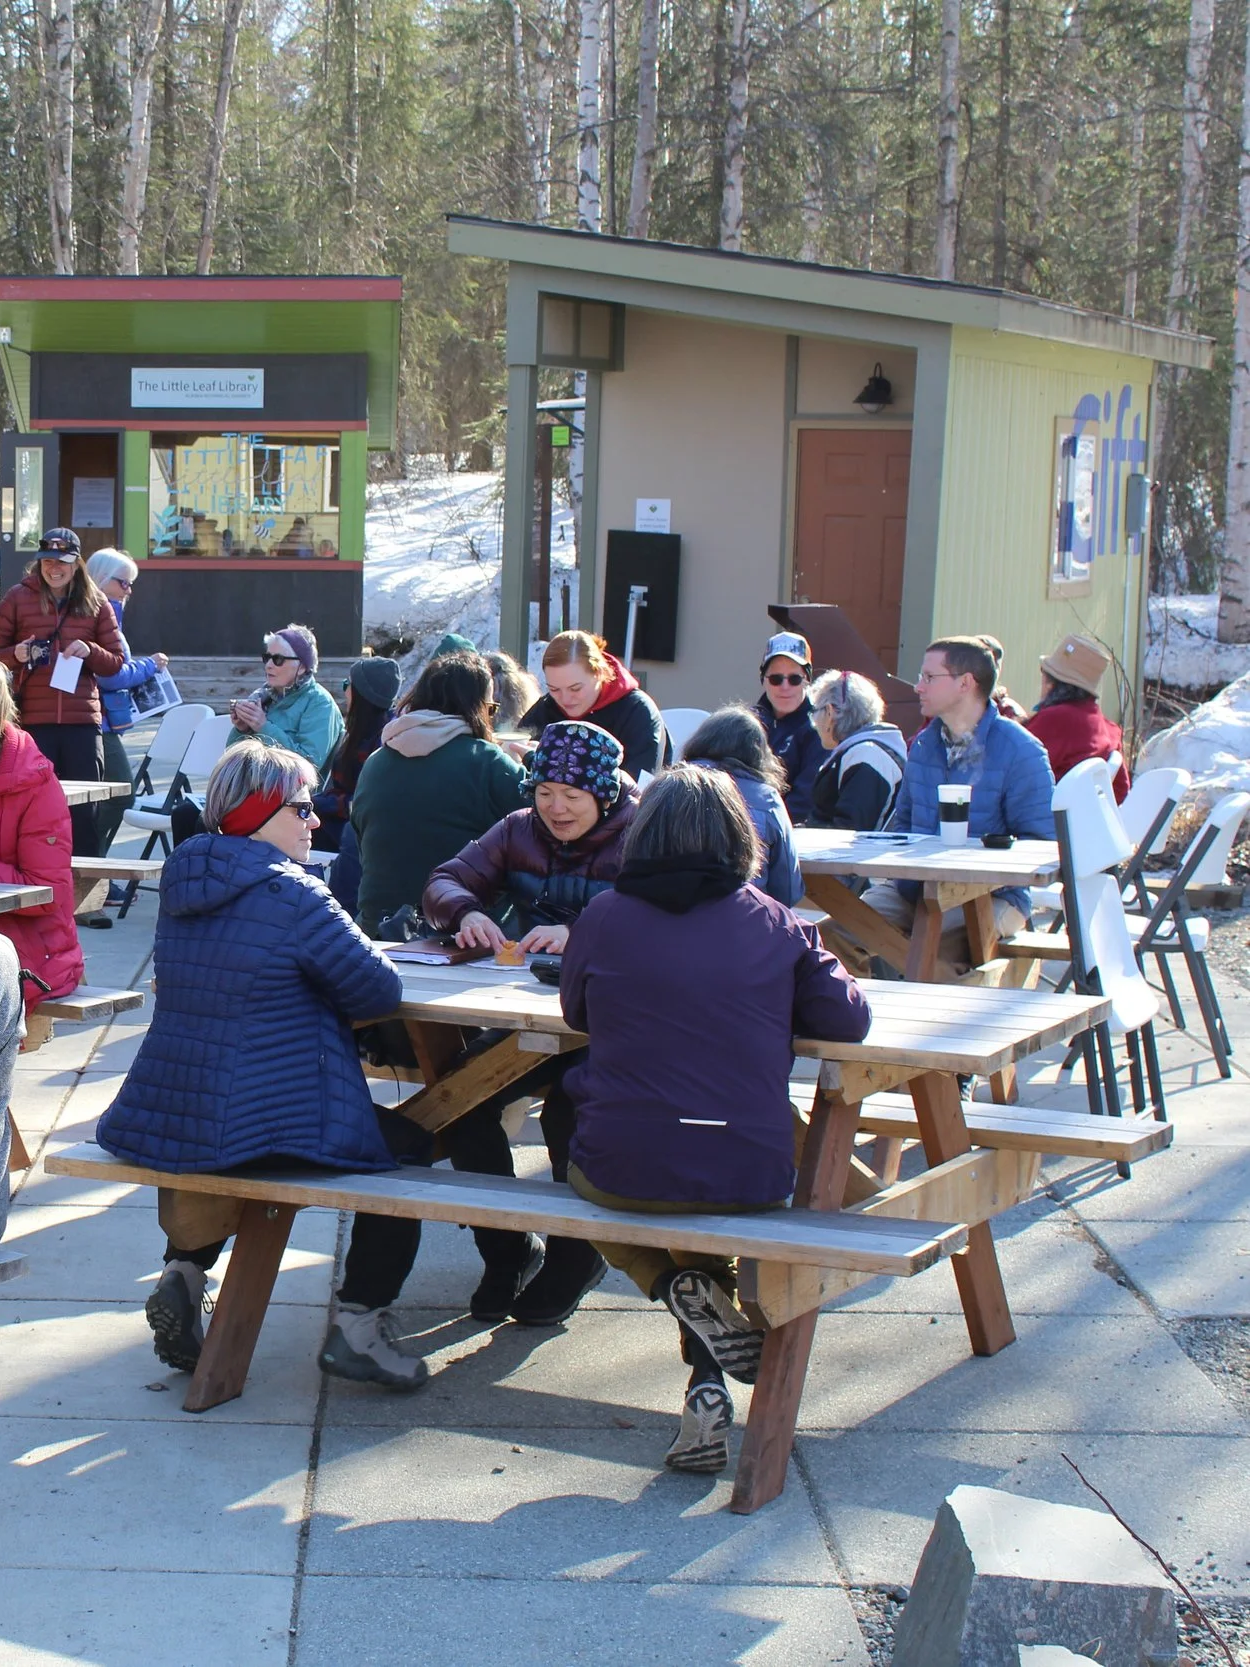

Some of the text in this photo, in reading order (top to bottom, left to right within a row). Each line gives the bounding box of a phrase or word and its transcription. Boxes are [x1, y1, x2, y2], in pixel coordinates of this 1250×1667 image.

[138, 380, 259, 395] The Little Leaf Library
[221, 432, 264, 450] THE
[194, 494, 287, 517] LIBRARY
